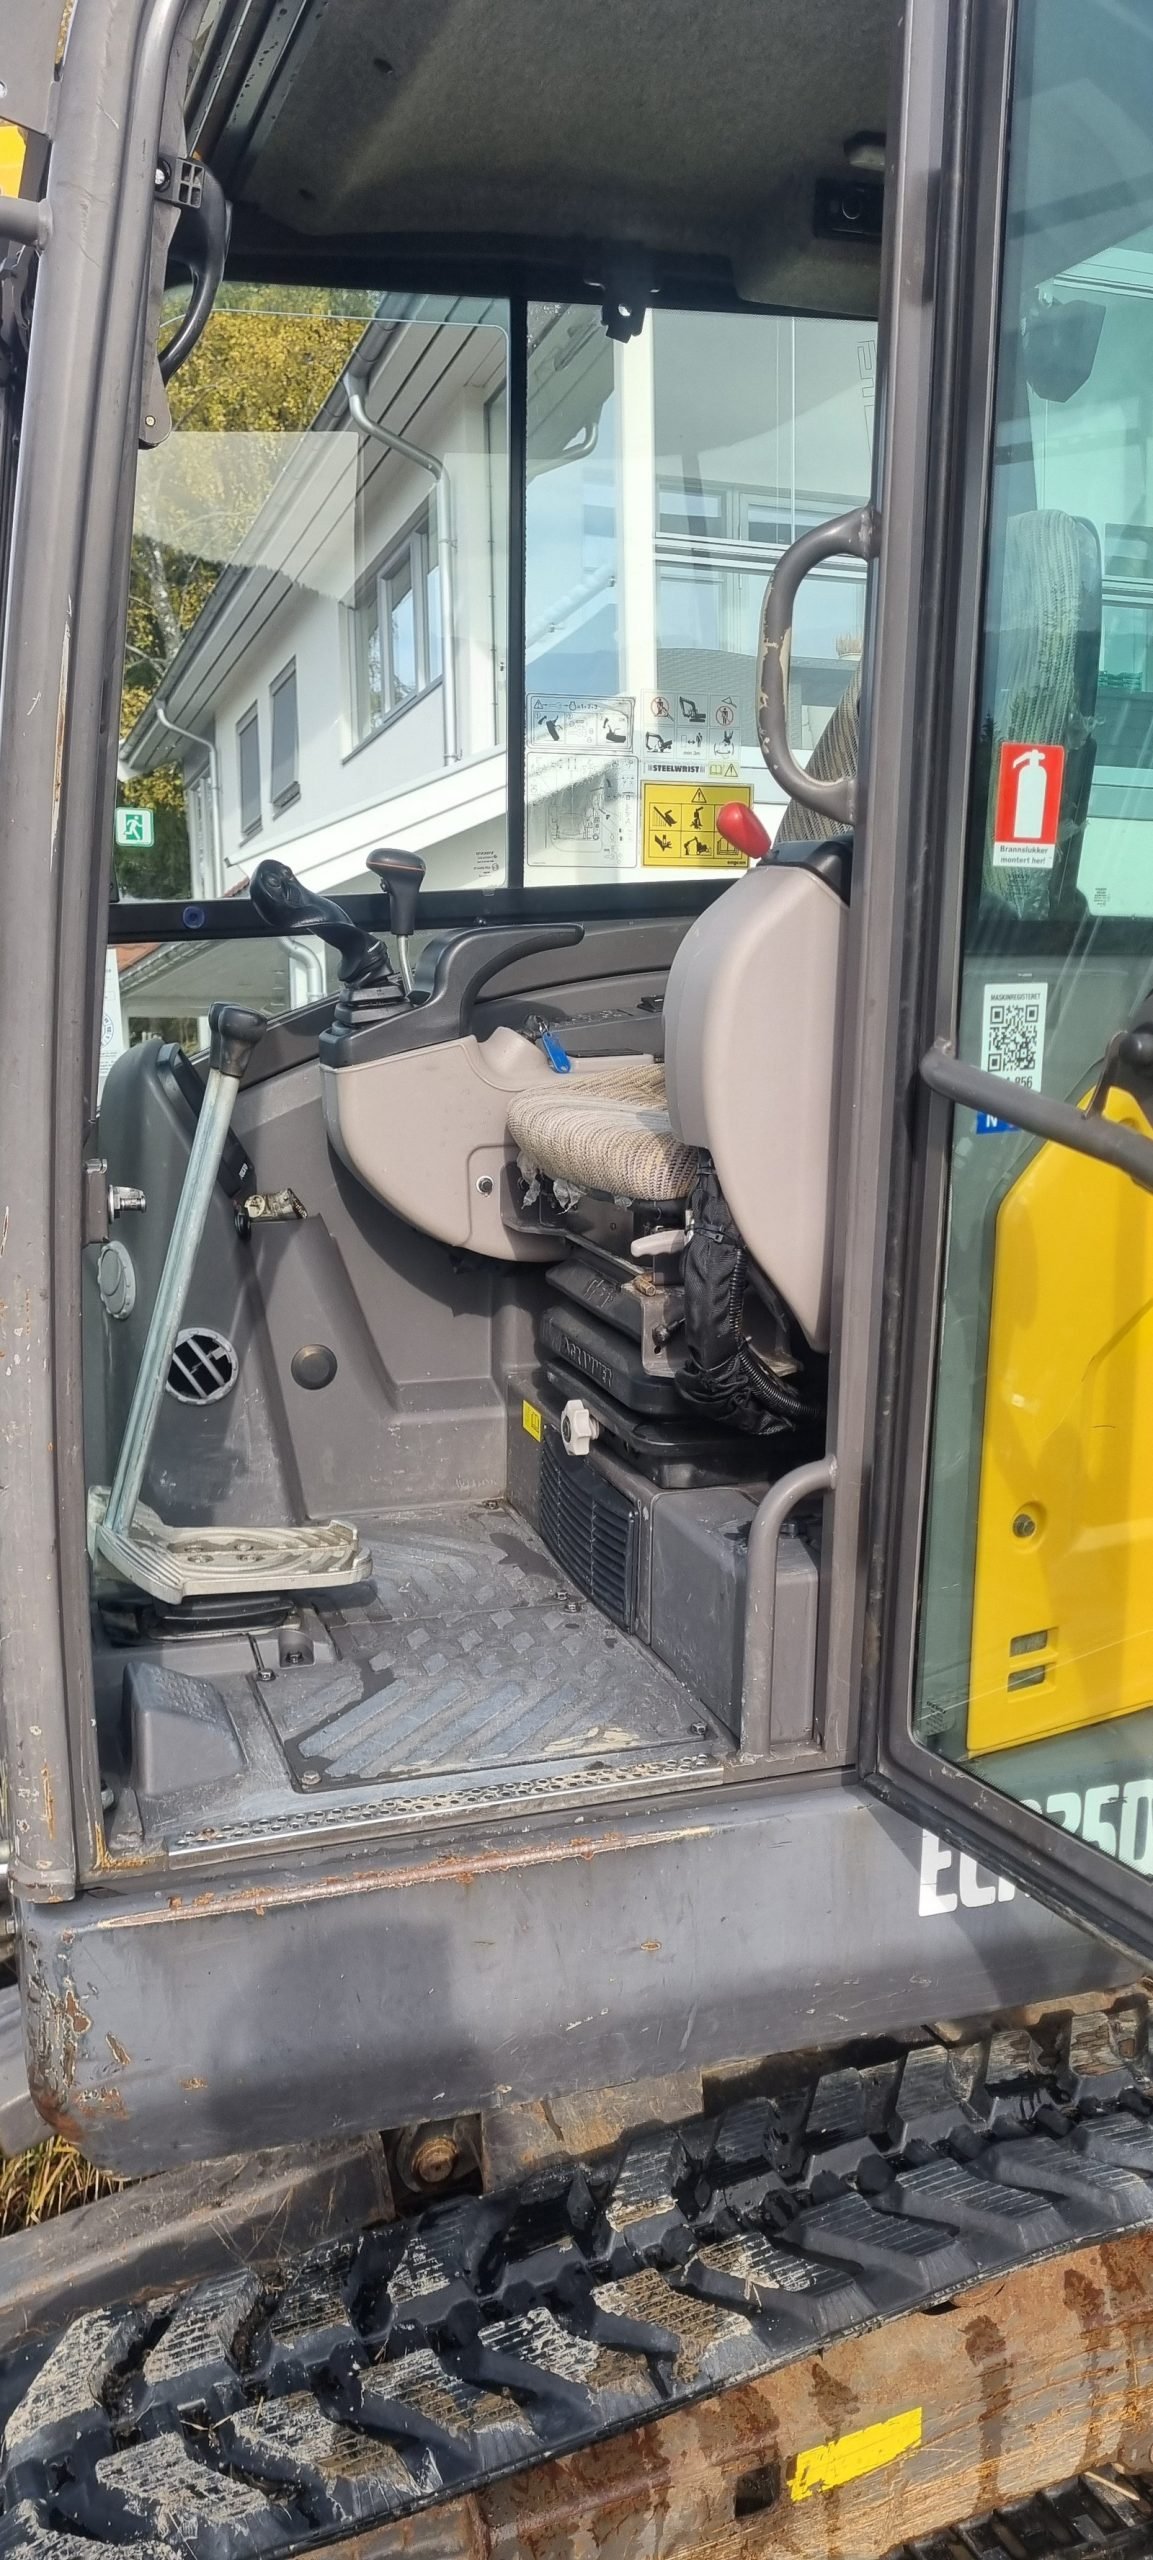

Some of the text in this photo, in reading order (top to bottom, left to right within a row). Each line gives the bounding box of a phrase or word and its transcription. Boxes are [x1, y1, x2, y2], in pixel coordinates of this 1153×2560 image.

[653, 764, 700, 773] STEELWRIST
[1000, 844, 1048, 854] Brannslukker
[1000, 856, 1046, 864] montert her!
[990, 992, 1041, 1001] MASKINREGISTERET
